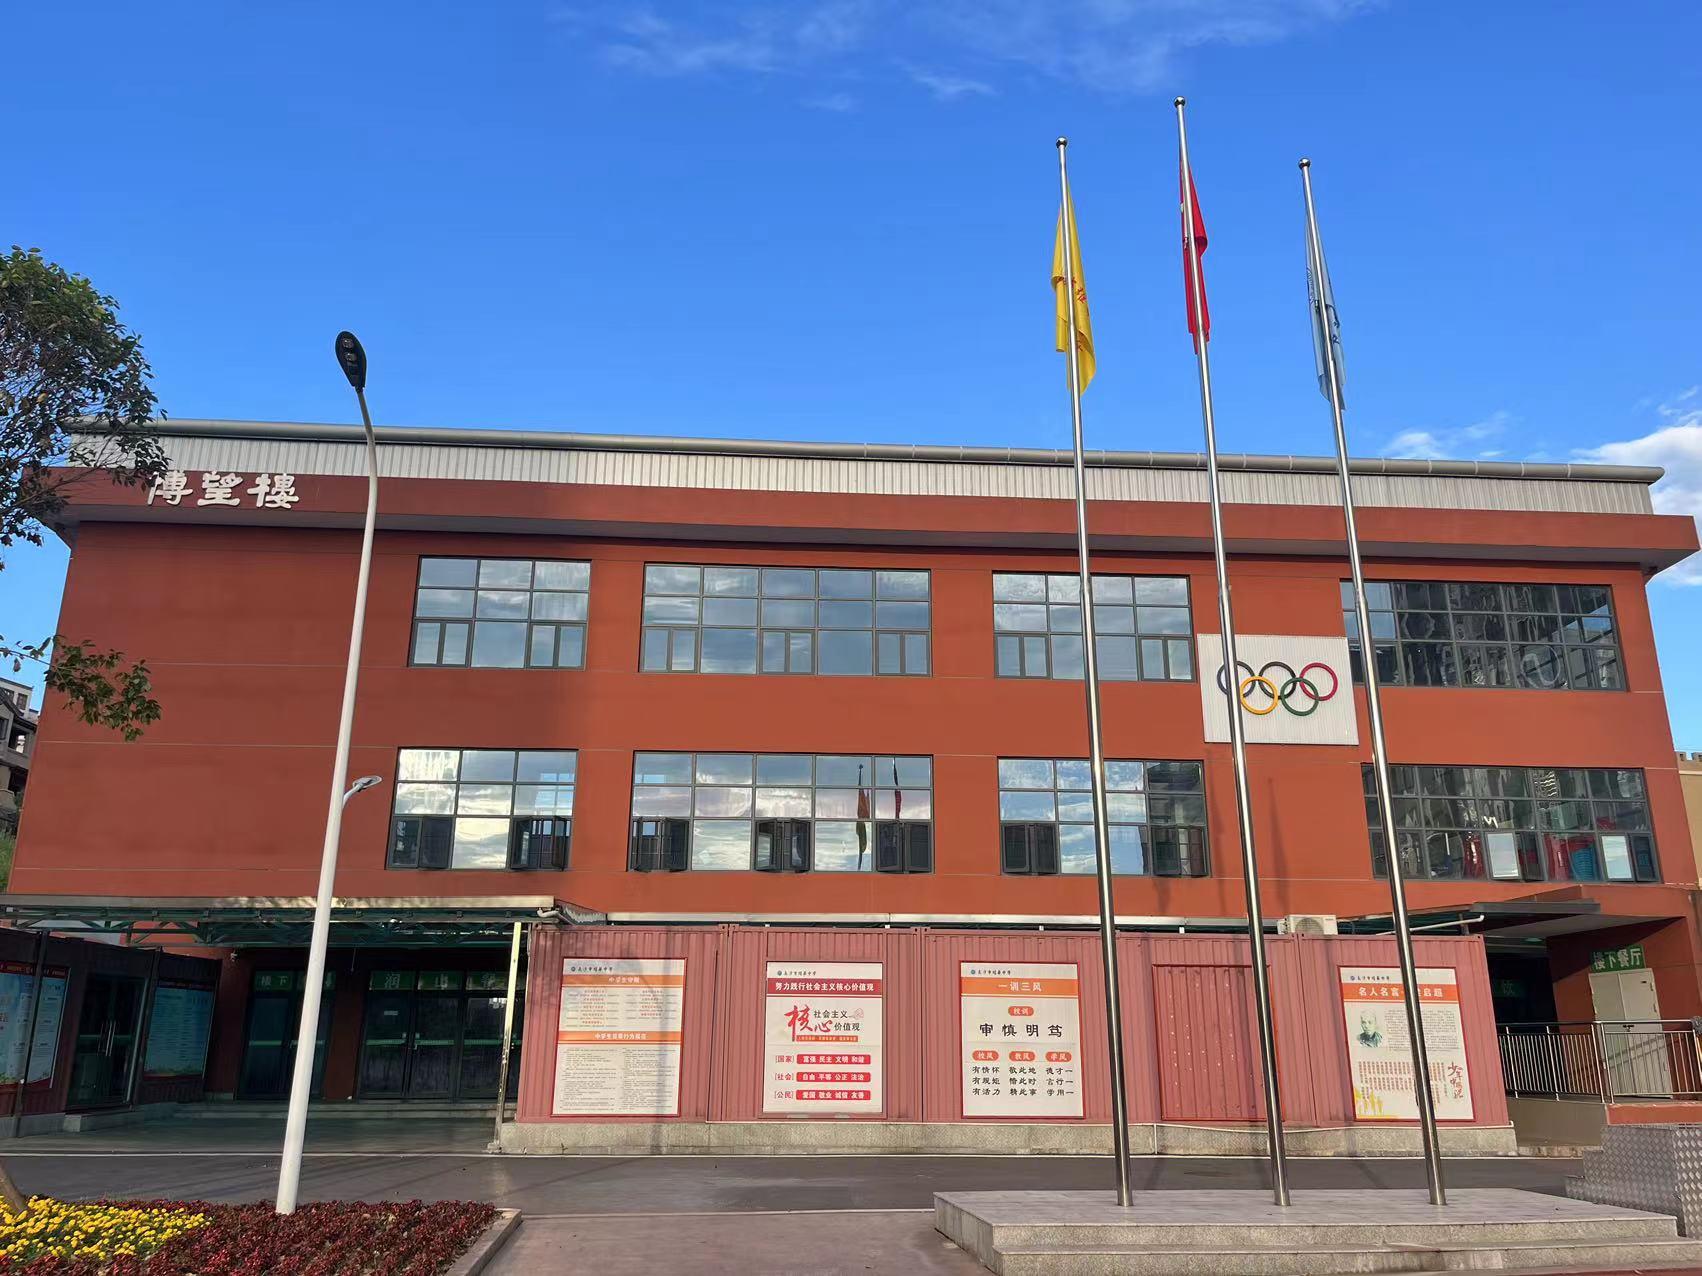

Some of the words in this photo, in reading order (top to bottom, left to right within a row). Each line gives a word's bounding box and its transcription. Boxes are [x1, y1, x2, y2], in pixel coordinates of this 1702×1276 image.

[1593, 947, 1641, 970] 楼下餐厅
[775, 982, 874, 991] 努力践行社会主义核心价值观
[998, 981, 1042, 992] 一训三风
[814, 1010, 848, 1019] 社会主义
[784, 1004, 813, 1043] 核
[815, 1020, 832, 1033] 心
[834, 1022, 861, 1031] 价值观
[979, 1023, 1063, 1037] 审慎明笃
[977, 1052, 994, 1060] 校风
[972, 1066, 1000, 1074] 有情怀
[802, 1073, 815, 1081] 自由
[819, 1073, 832, 1081] 平等
[835, 1073, 848, 1081] 公正
[850, 1073, 864, 1081] 法治
[972, 1077, 1000, 1085] 有规矩
[803, 1091, 816, 1099] 爱国
[819, 1091, 832, 1099] 敬业
[835, 1091, 848, 1099] 诚信
[851, 1091, 865, 1099] 友善
[972, 1088, 1001, 1096] 有活力
